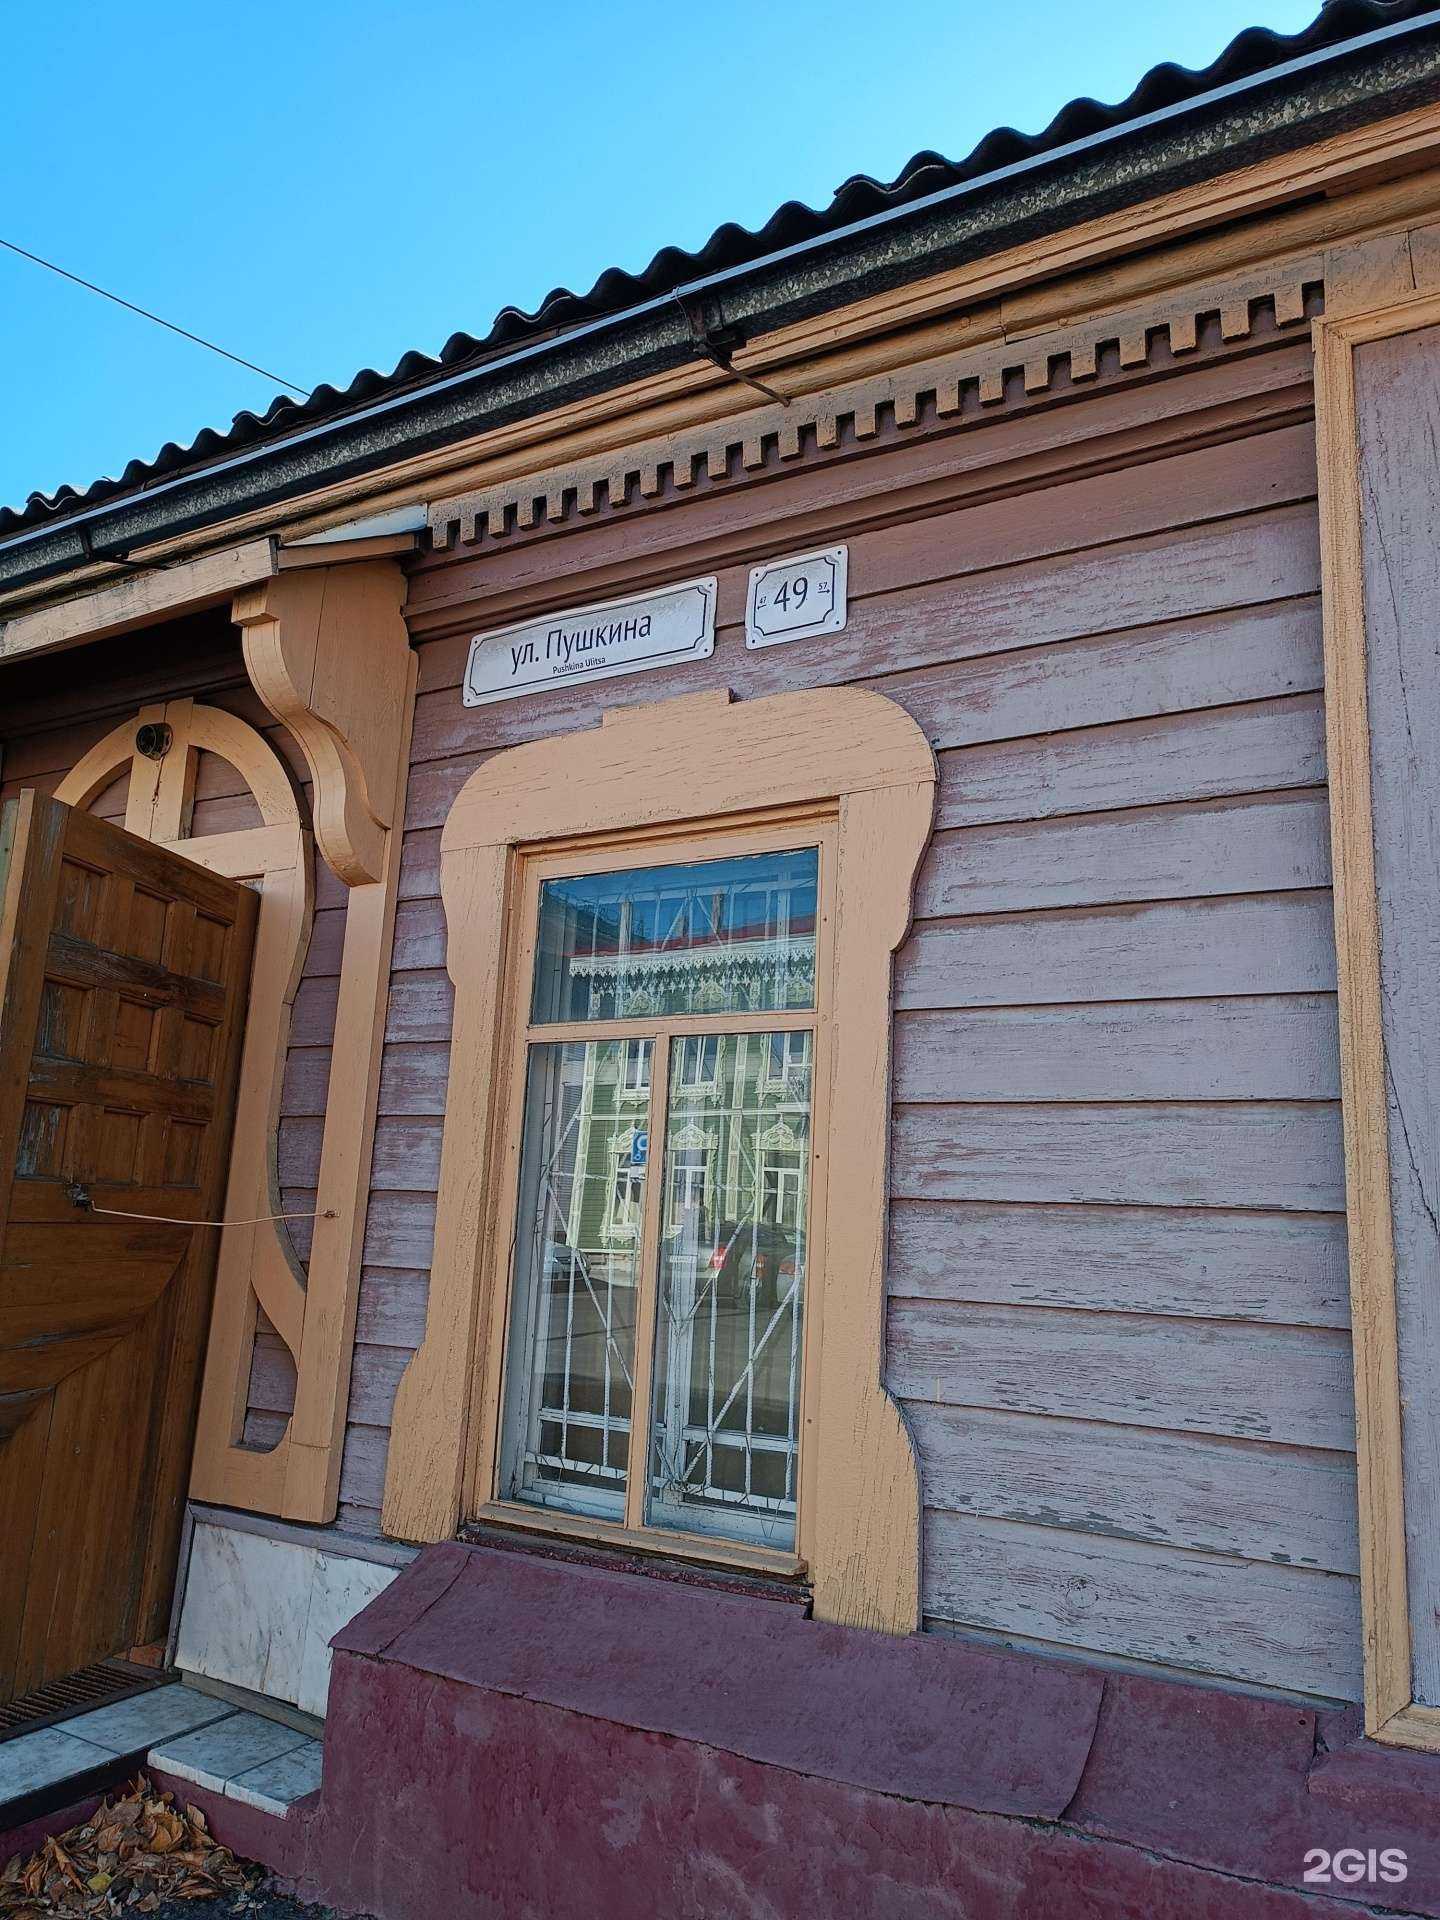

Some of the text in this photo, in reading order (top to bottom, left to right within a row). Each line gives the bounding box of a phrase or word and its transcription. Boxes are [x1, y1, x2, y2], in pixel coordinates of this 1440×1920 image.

[773, 576, 808, 612] 49
[818, 581, 828, 591] 57
[511, 615, 652, 675] ул. Пушкина
[552, 656, 606, 674] Pushkina Ulitsa
